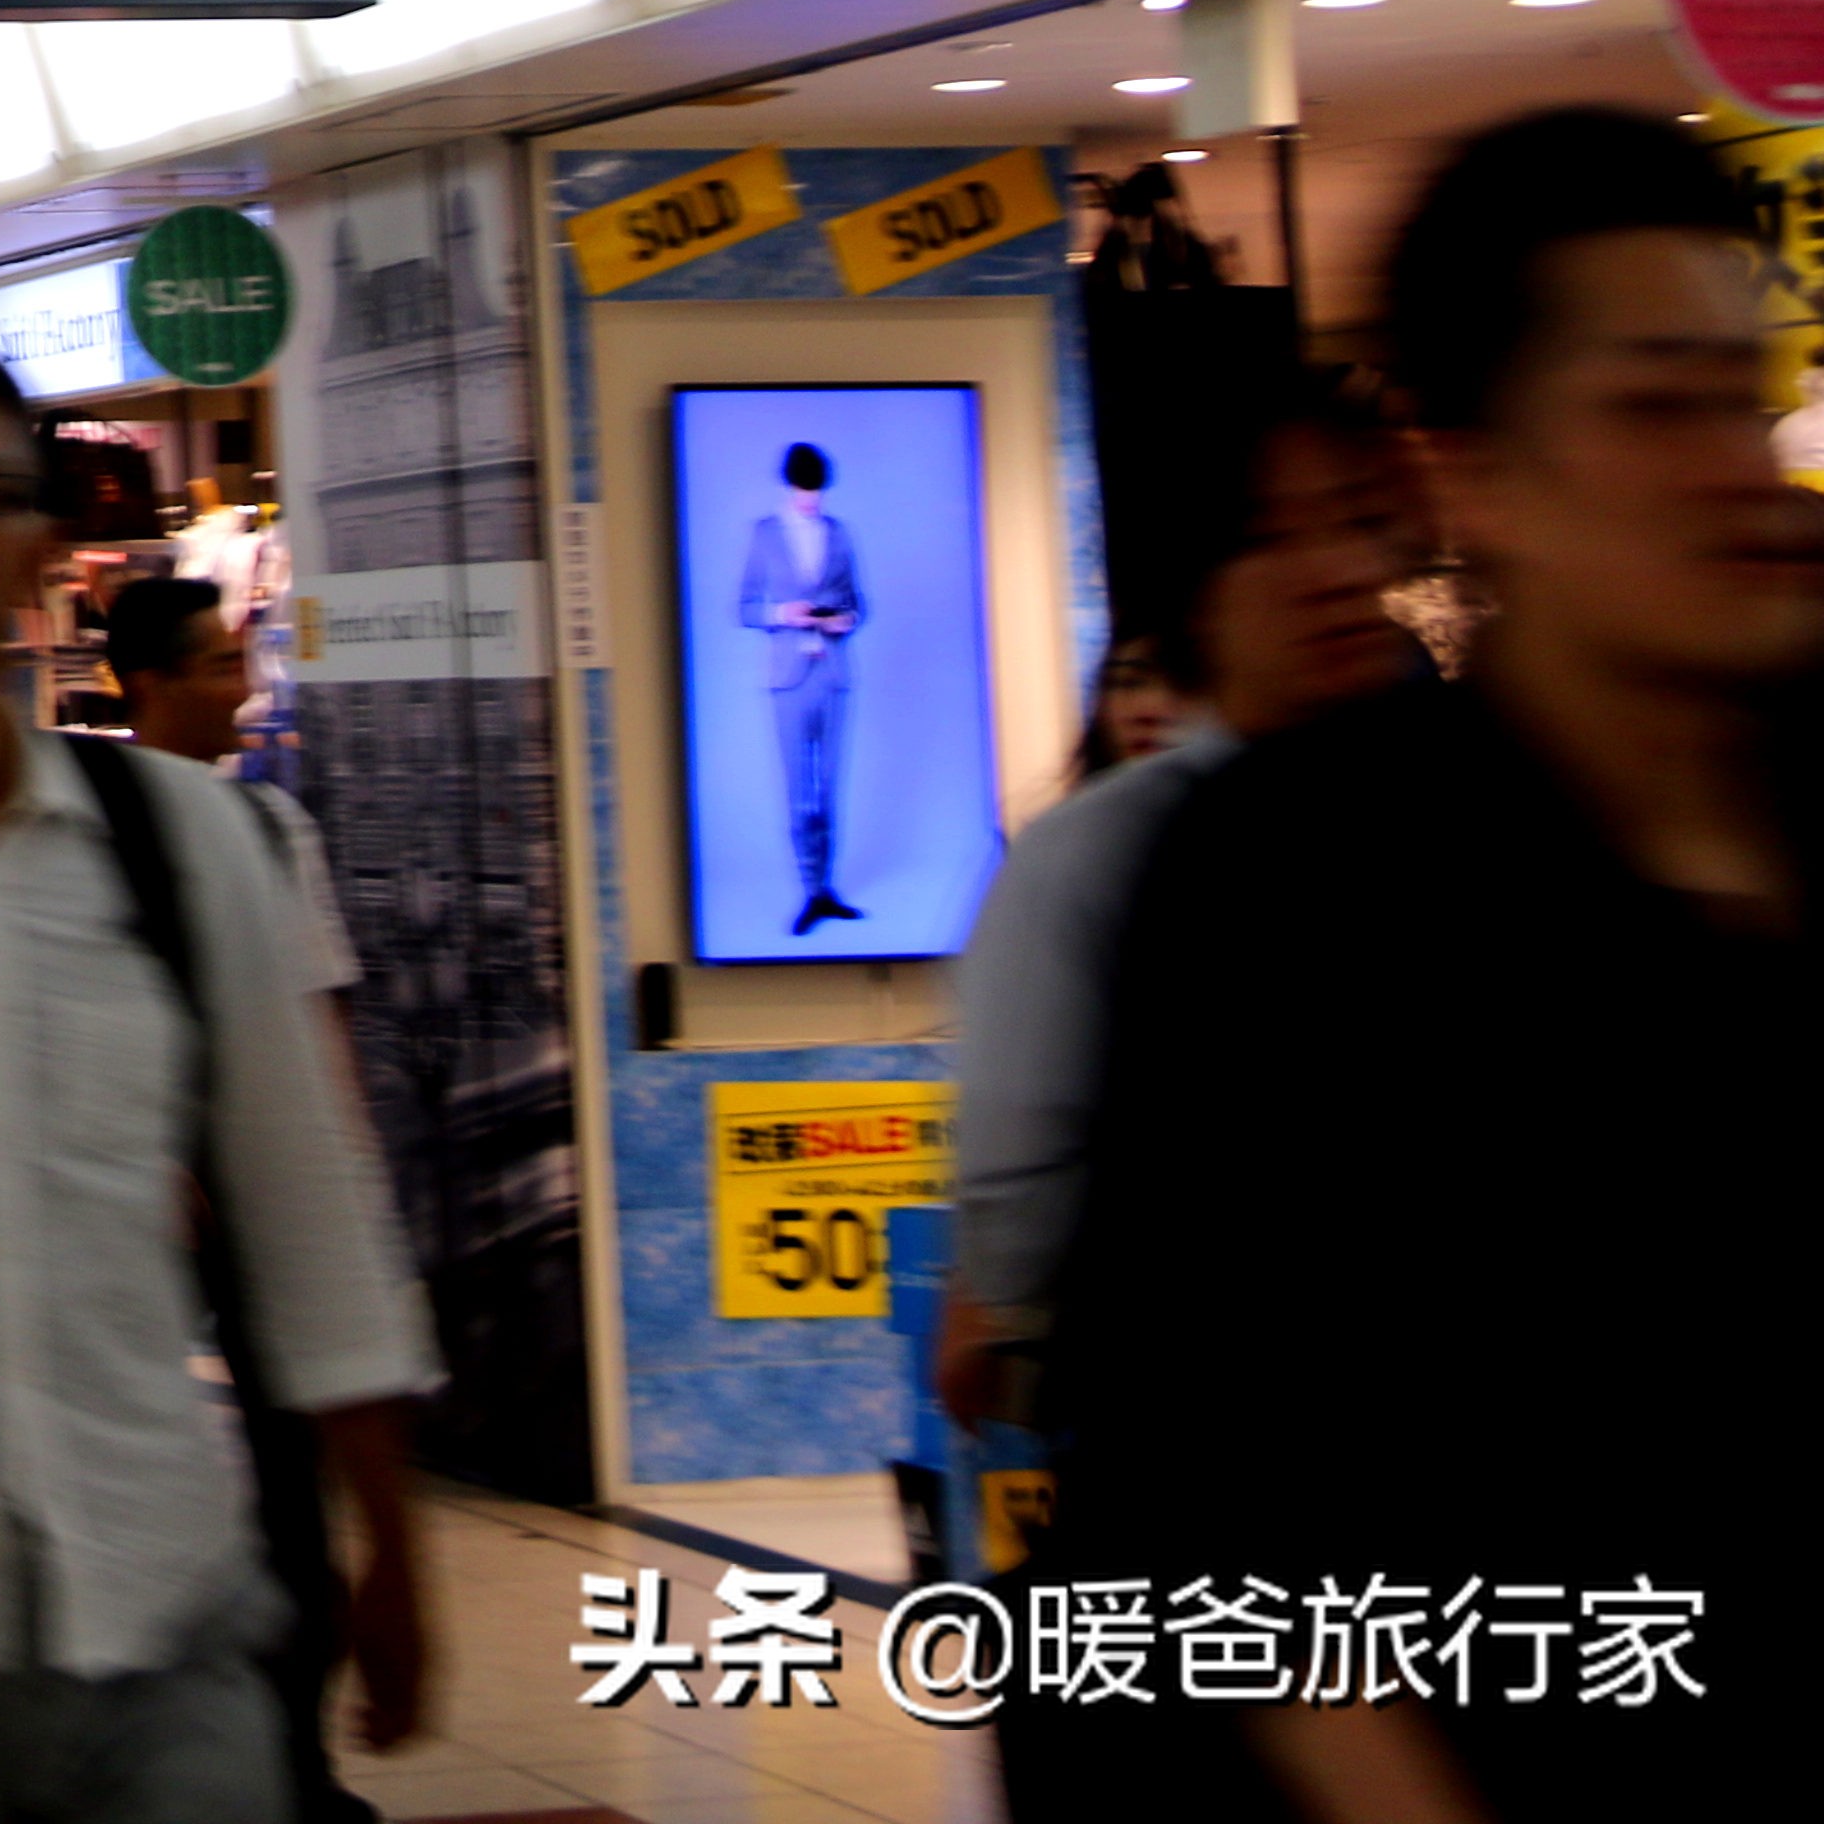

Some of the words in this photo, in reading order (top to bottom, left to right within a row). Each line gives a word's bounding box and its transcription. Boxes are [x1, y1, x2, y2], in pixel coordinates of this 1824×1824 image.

[622, 178, 743, 263] SOLD
[882, 178, 1003, 264] SOLD
[143, 275, 275, 316] SALE
